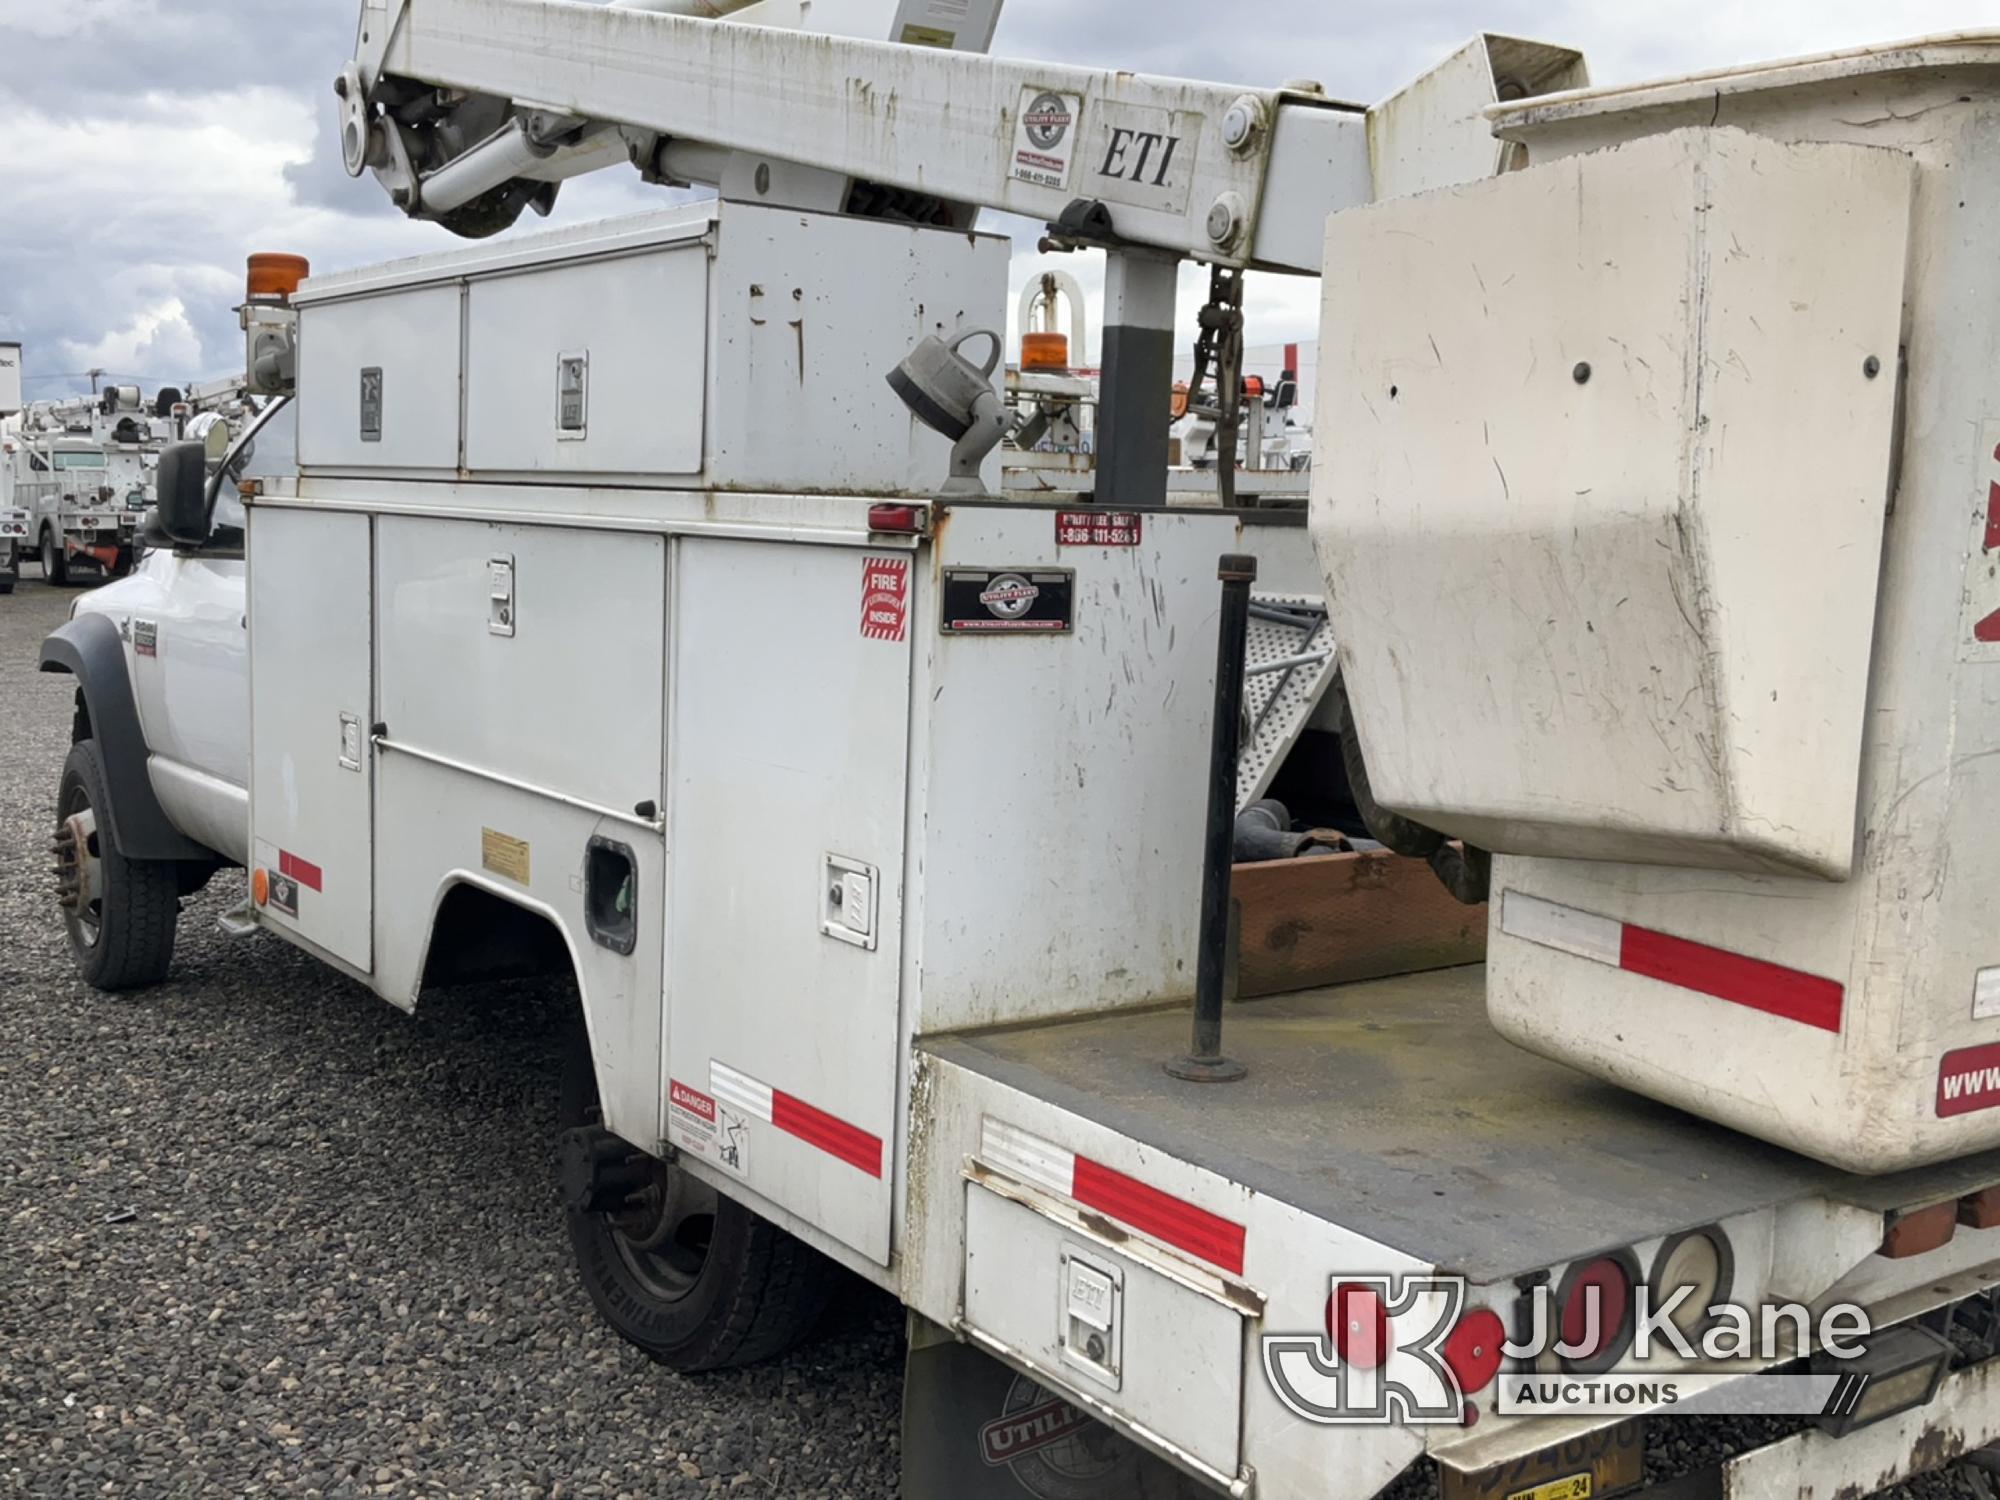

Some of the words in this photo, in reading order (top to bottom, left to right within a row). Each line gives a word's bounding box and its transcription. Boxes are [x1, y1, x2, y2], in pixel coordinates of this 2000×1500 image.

[1098, 127, 1181, 187] ETI
[871, 574, 898, 591] FIRE
[869, 610, 897, 625] INSIDE
[680, 1090, 713, 1116] DANGER
[1573, 1477, 1588, 1497] 24
